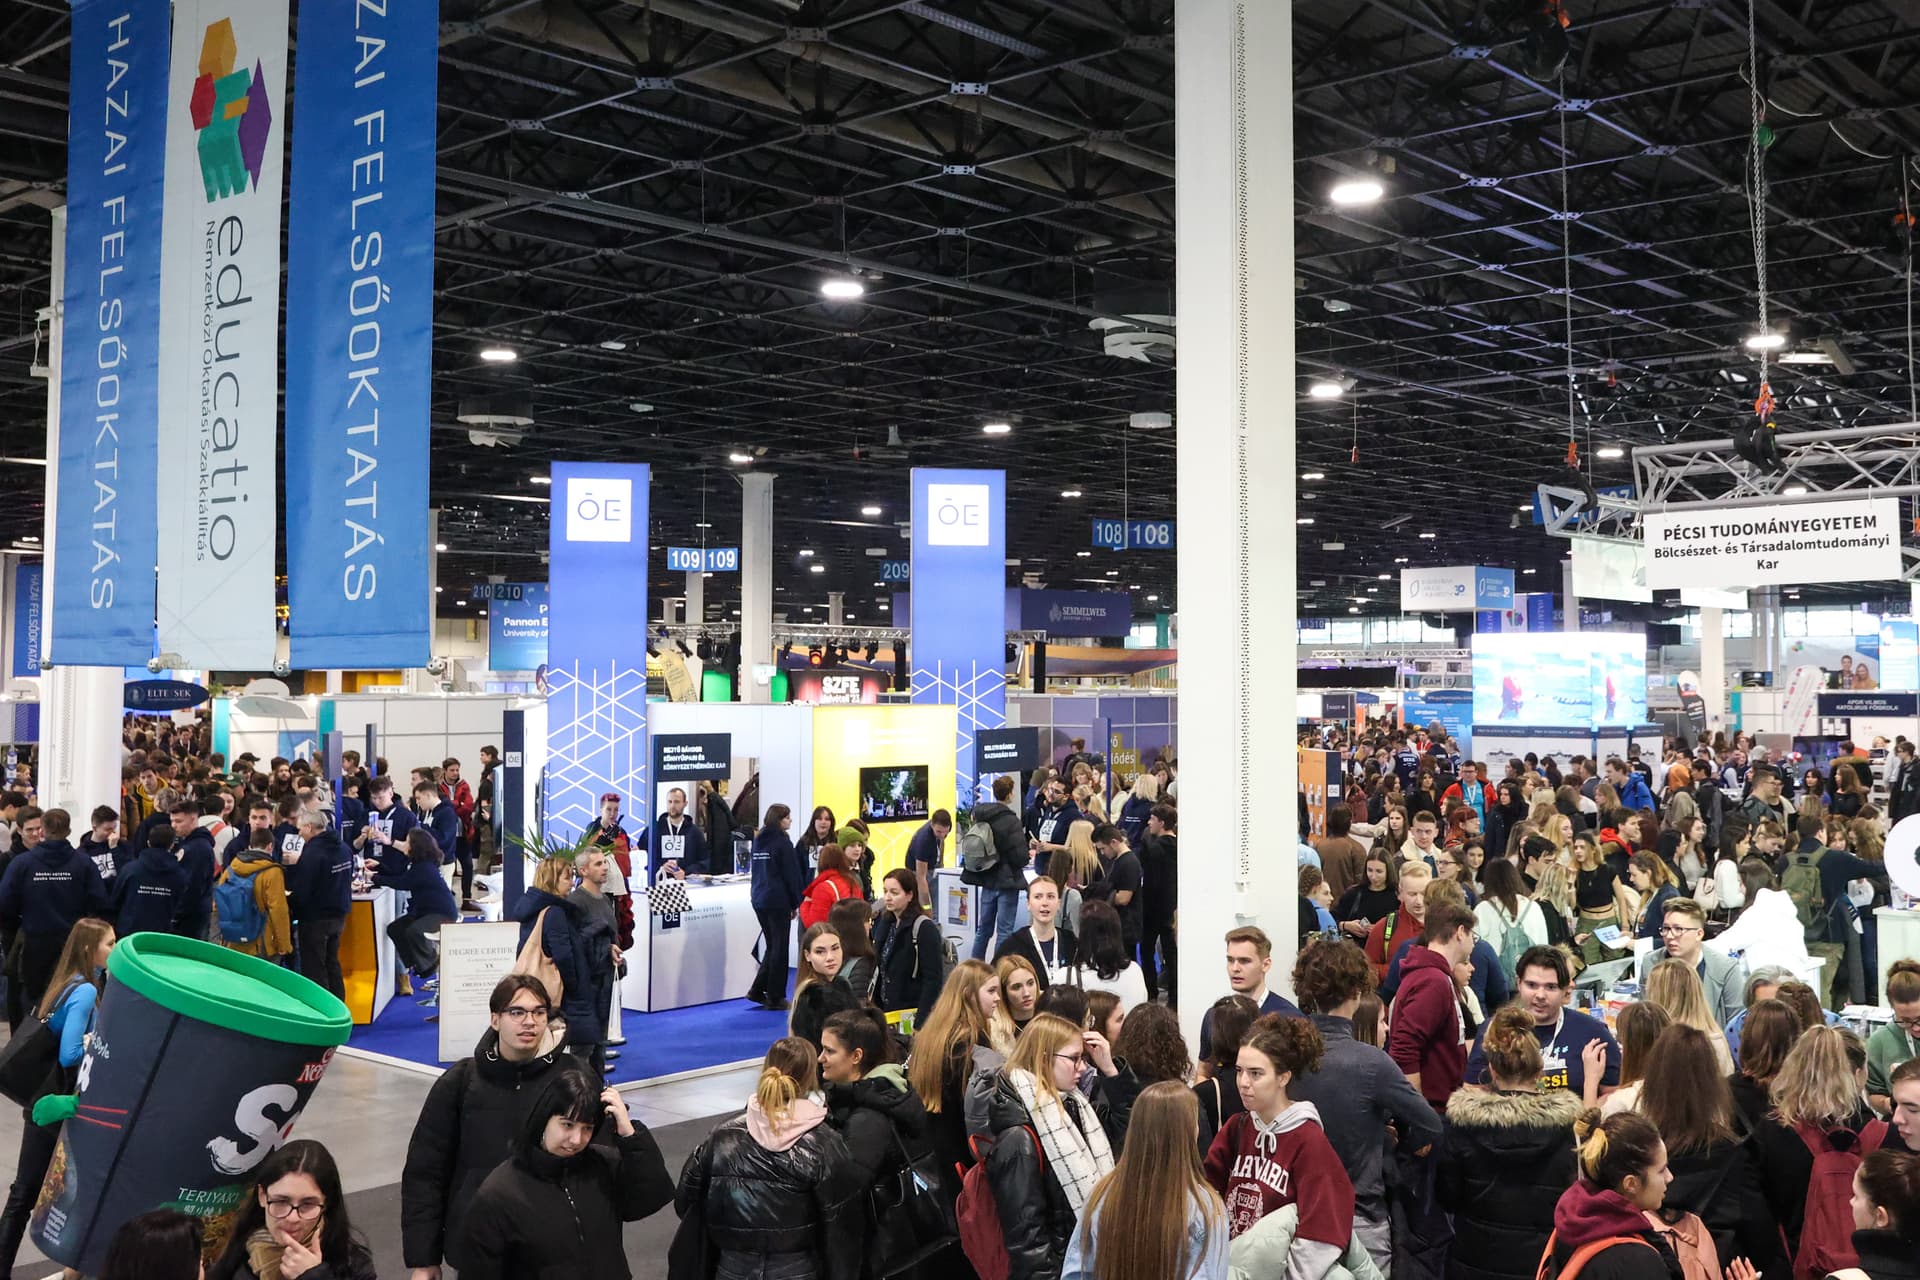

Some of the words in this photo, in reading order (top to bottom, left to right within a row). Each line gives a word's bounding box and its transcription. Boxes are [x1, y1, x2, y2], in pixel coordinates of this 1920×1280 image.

[103, 12, 130, 176] HAZAI
[203, 220, 216, 343] Nemzetközi
[344, 110, 391, 602] FELSŐOKTATÁS
[200, 348, 213, 433] Oktatási
[209, 215, 252, 561] educatio
[90, 197, 128, 609] FELSŐOKTATÁS
[197, 438, 210, 561] Szakkiállítás
[1097, 522, 1122, 544] 108
[1133, 524, 1169, 544] 108
[1663, 525, 1706, 541] PÉCSI
[1710, 515, 1878, 538] TUDOMÁNYEGYETEM
[1654, 545, 1722, 559] Bölcsészet-
[1725, 542, 1738, 554] és
[1741, 534, 1890, 554] Társadalomtudományi
[672, 550, 700, 568] 109
[708, 550, 735, 568] 109
[1757, 558, 1779, 570] Kar
[883, 563, 910, 579] 209
[473, 585, 491, 598] 210
[497, 586, 520, 599] 210
[1062, 606, 1106, 617] SEMMELWEIS
[503, 617, 540, 627] Pannon
[503, 629, 538, 638] University
[822, 676, 860, 694] SZFE
[1422, 677, 1453, 686] GAMS
[1541, 1069, 1568, 1088] csi
[178, 1187, 240, 1204] TERIYAKI
